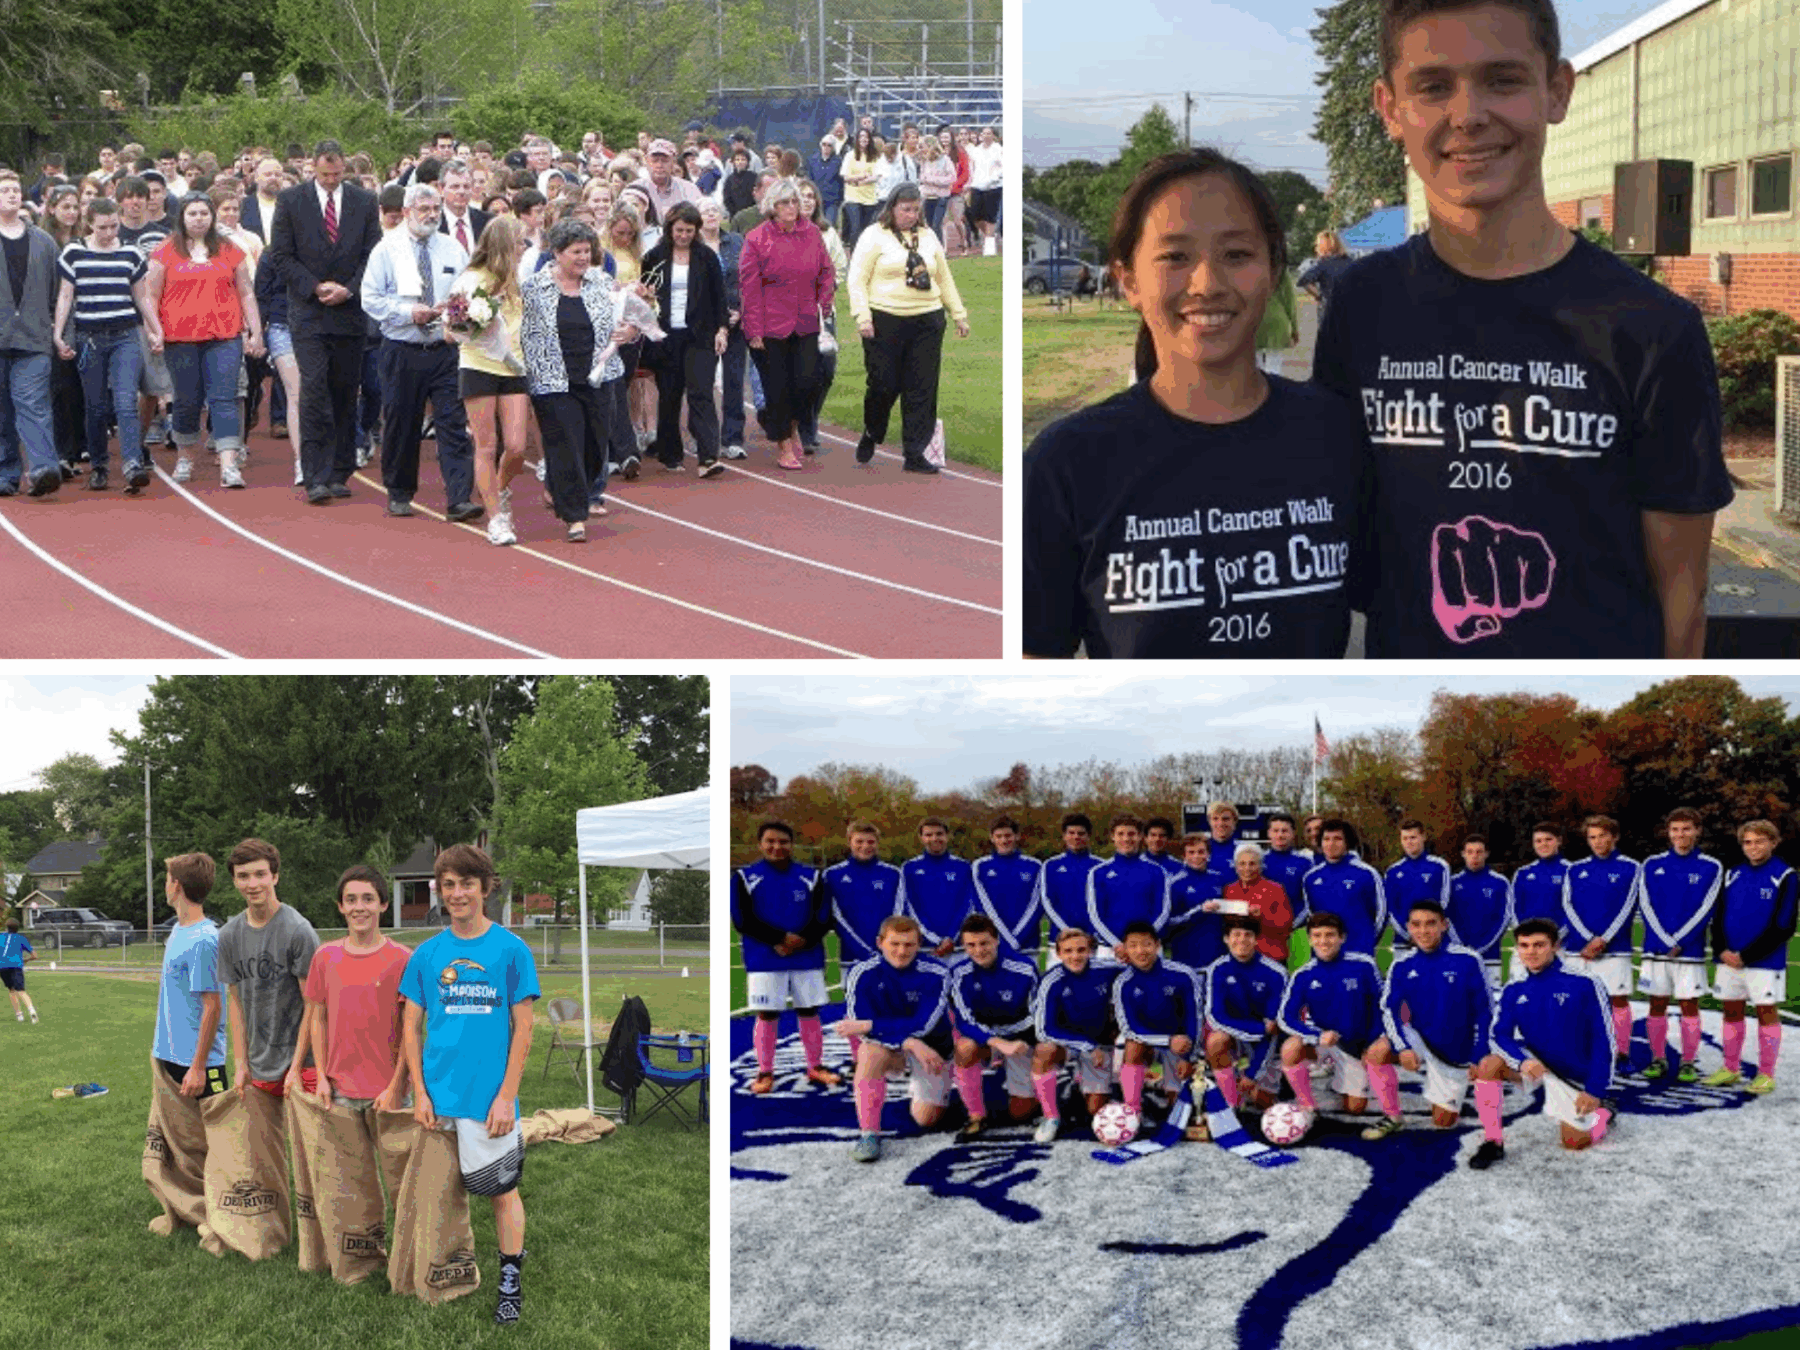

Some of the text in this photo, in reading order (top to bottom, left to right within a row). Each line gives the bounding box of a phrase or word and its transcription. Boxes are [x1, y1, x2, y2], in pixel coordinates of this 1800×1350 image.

[1378, 353, 1588, 389] Annual Cancer Walk
[1361, 387, 1618, 452] Fight for a Cure
[1448, 461, 1512, 489] 2016
[1124, 496, 1335, 542] Annual Cancer Walk
[1104, 533, 1349, 609] Fight for a Cure
[1208, 612, 1272, 643] 2016
